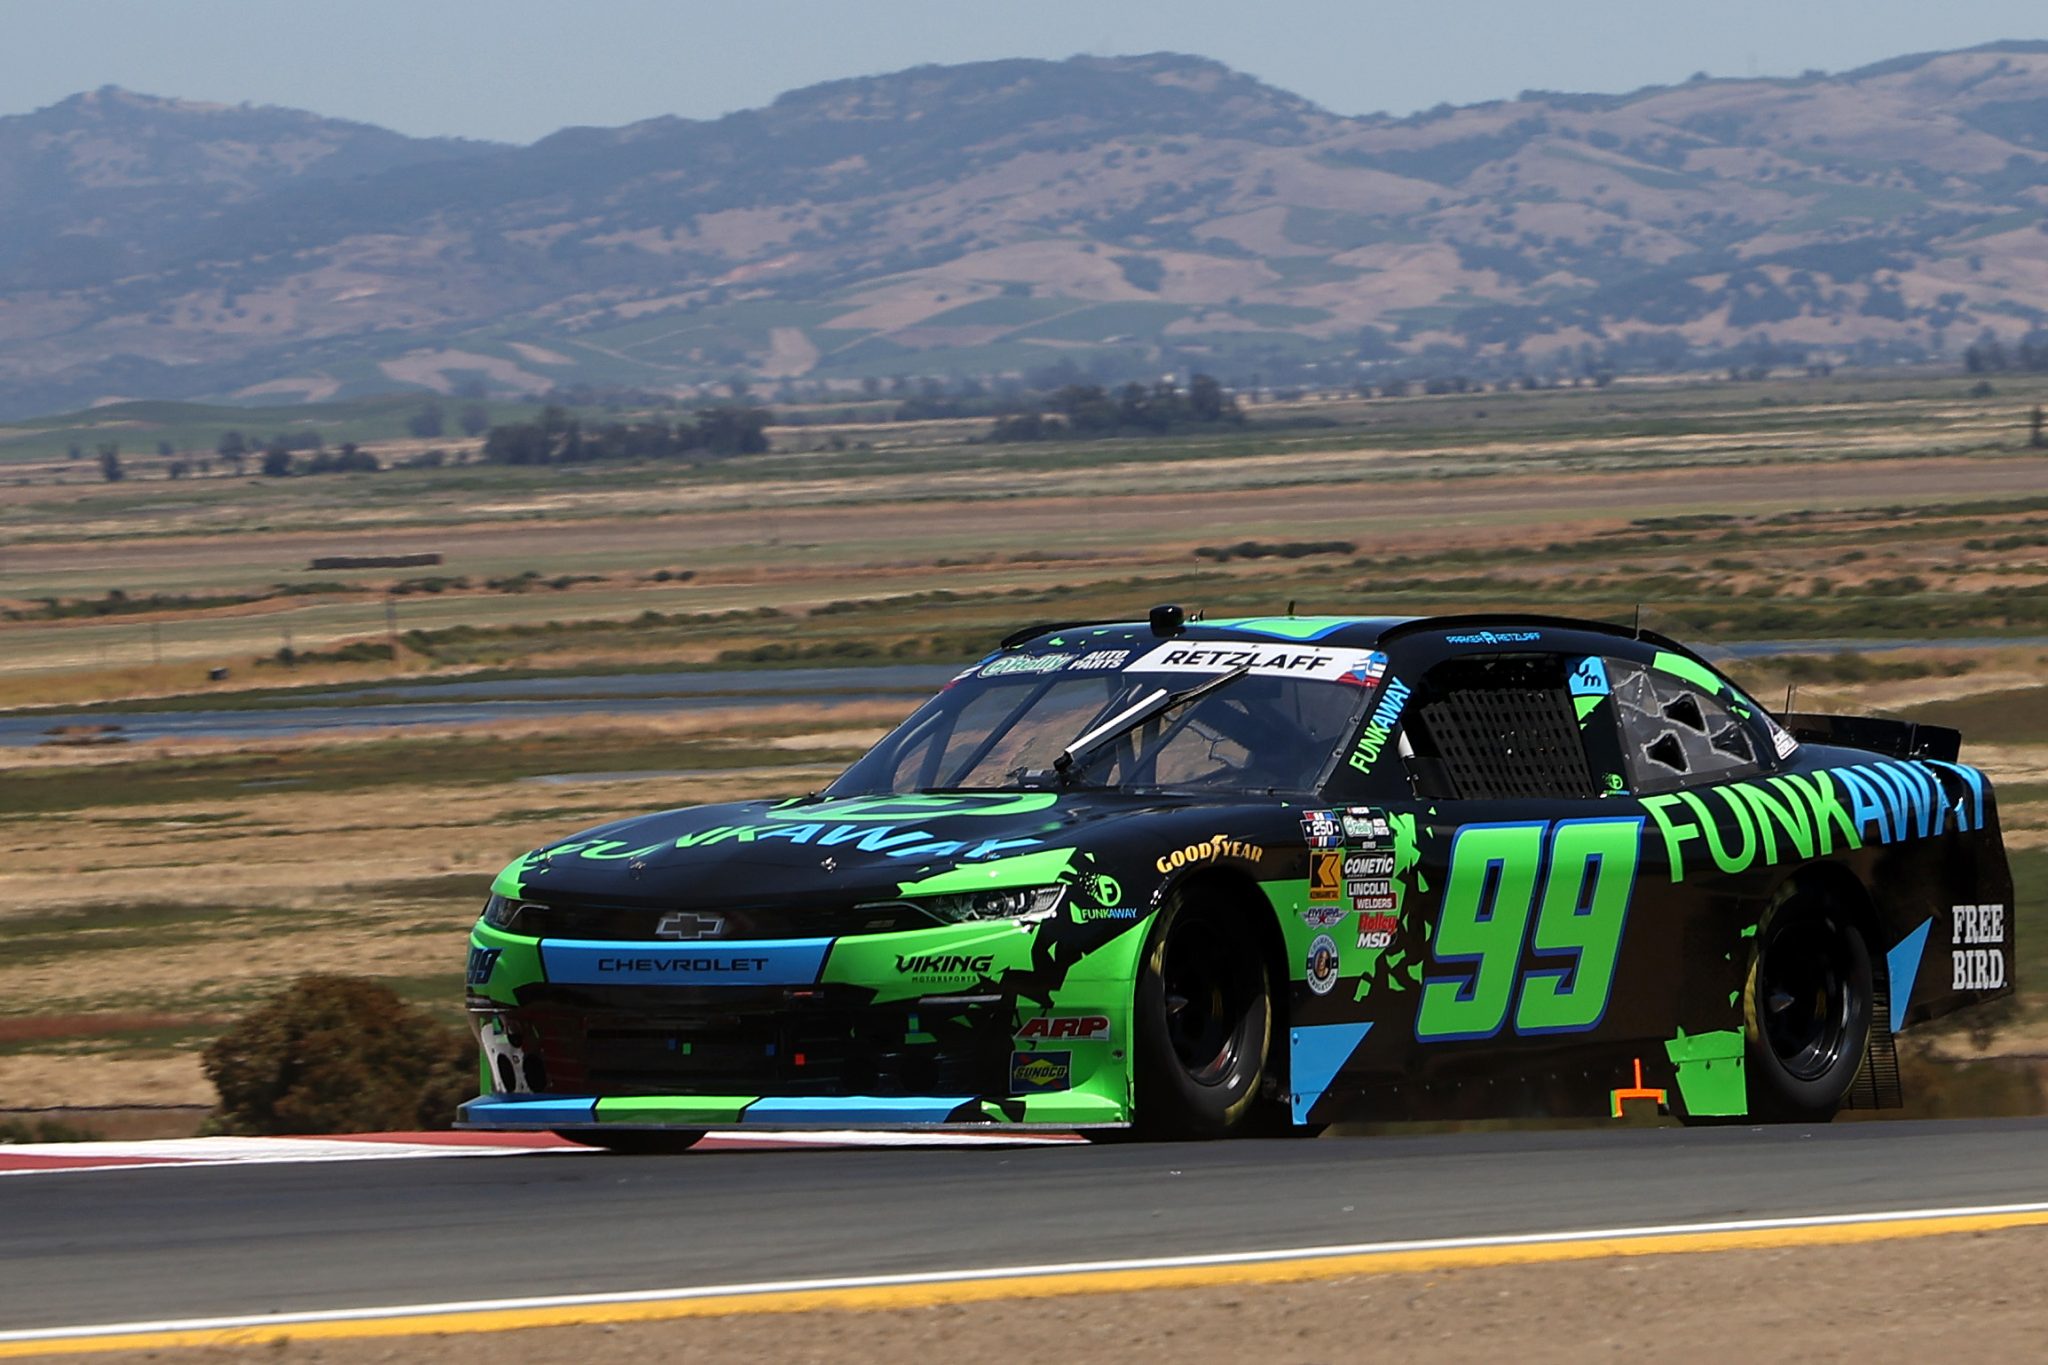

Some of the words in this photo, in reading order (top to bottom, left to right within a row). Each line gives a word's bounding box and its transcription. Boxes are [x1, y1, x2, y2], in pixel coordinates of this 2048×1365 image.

[1086, 650, 1131, 660] AUTO
[1160, 650, 1333, 672] RETZLAFF
[1068, 659, 1126, 670] PARTS
[1349, 676, 1412, 775] FUNKAWAY
[1312, 820, 1334, 836] 250
[1638, 759, 1985, 883] FUNKAWAY
[1156, 834, 1263, 873] GOODYEAR
[1344, 855, 1394, 874] COMETIC
[1348, 882, 1389, 896] LINCOLN
[1357, 898, 1393, 910] WELDERS
[1082, 908, 1137, 919] FUNKAWAY
[1414, 815, 1646, 1043] 99
[1952, 904, 2004, 944] FREE
[1356, 933, 1392, 949] MSD
[598, 958, 769, 972] CHEVROLET
[894, 954, 995, 973] VIKING
[1017, 1016, 1109, 1038] ARP
[1014, 1064, 1068, 1079] SUNOCO
